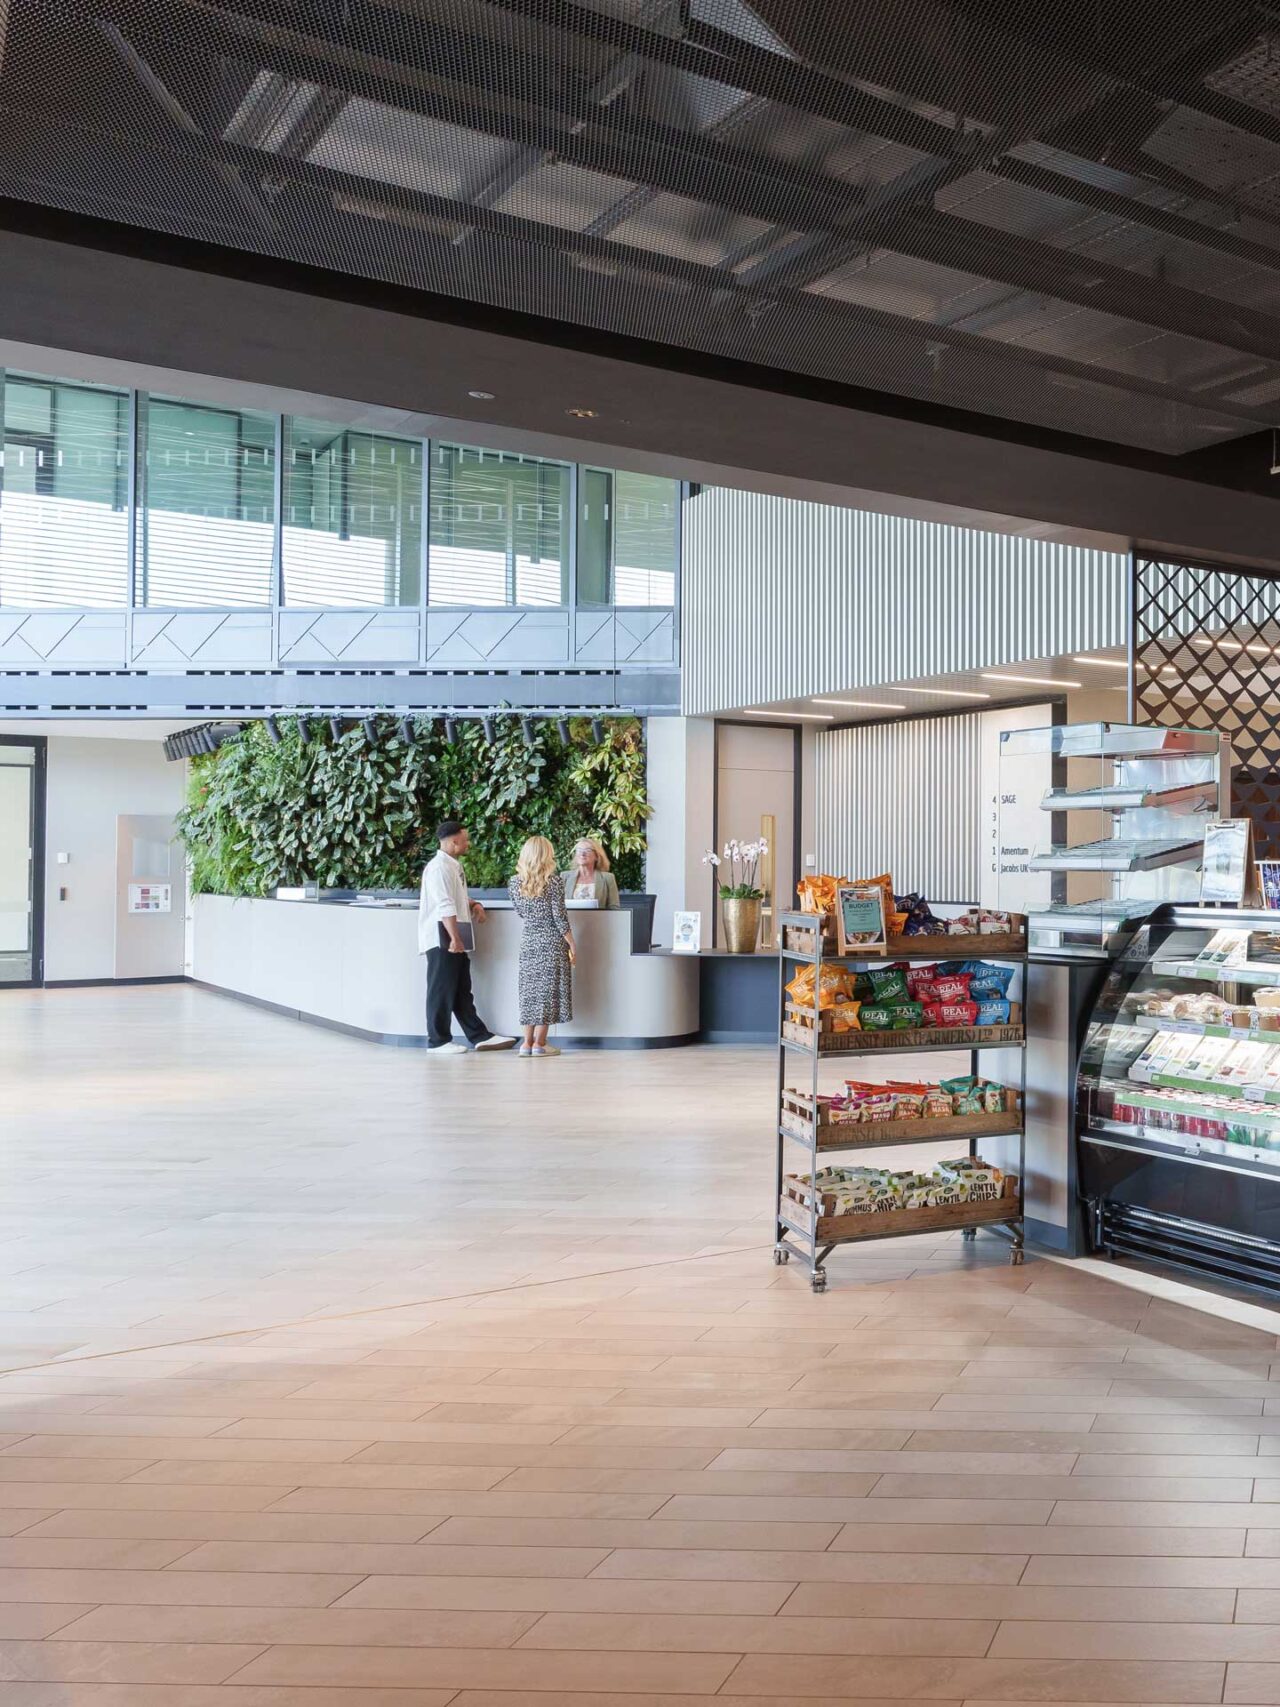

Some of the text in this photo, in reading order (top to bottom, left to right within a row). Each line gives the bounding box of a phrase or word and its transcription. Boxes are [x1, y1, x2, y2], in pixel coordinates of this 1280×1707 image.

[992, 794, 1016, 804] 4 SAGE
[992, 812, 996, 822] 3
[992, 830, 996, 838] 2
[992, 846, 1029, 856] 1 Amentum
[1000, 864, 1019, 874] Jacobs
[1020, 864, 1028, 872] UK
[848, 902, 873, 910] BUDGET
[940, 982, 963, 993] REAL
[943, 1008, 968, 1016] REAL
[980, 1003, 1002, 1012] REAL
[864, 1012, 888, 1020] REAL
[970, 1182, 997, 1192] LENTIL
[935, 1194, 960, 1204] LENTIL
[970, 1192, 998, 1201] CHIPS
